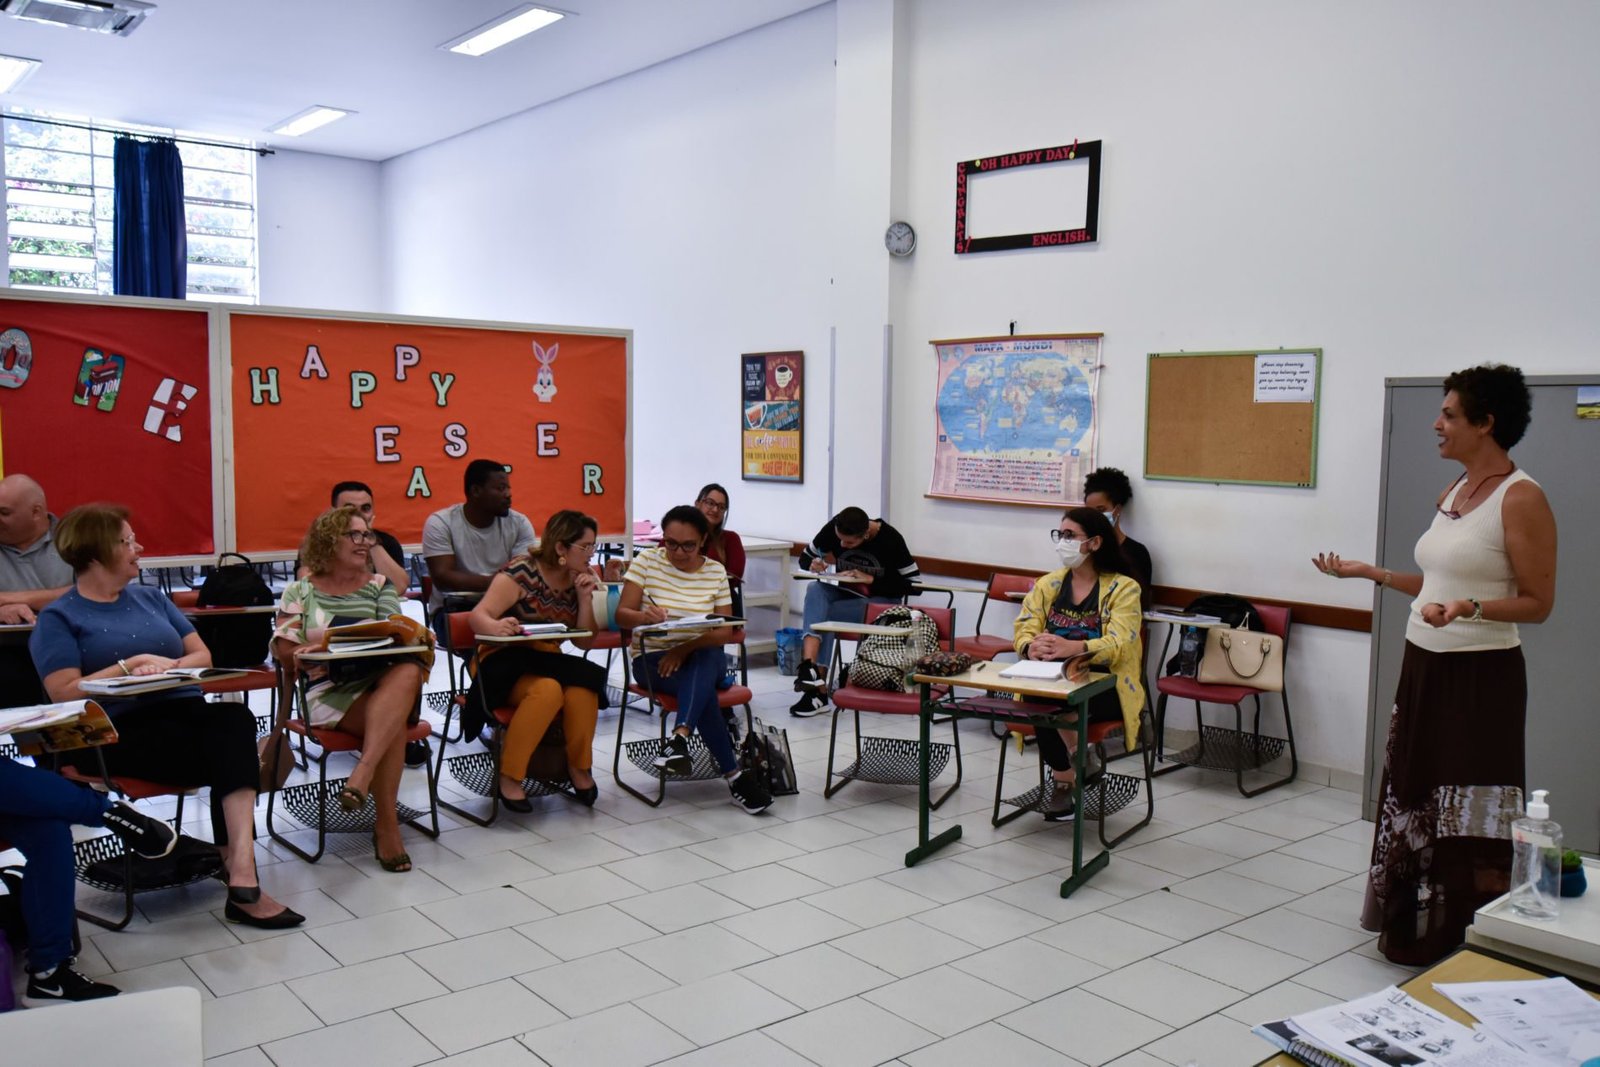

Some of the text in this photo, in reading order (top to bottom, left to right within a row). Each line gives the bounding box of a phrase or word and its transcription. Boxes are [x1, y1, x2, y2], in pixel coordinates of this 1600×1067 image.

[980, 160, 997, 171] OH
[1000, 150, 1043, 167] HAPPY
[374, 422, 605, 496] EASER
